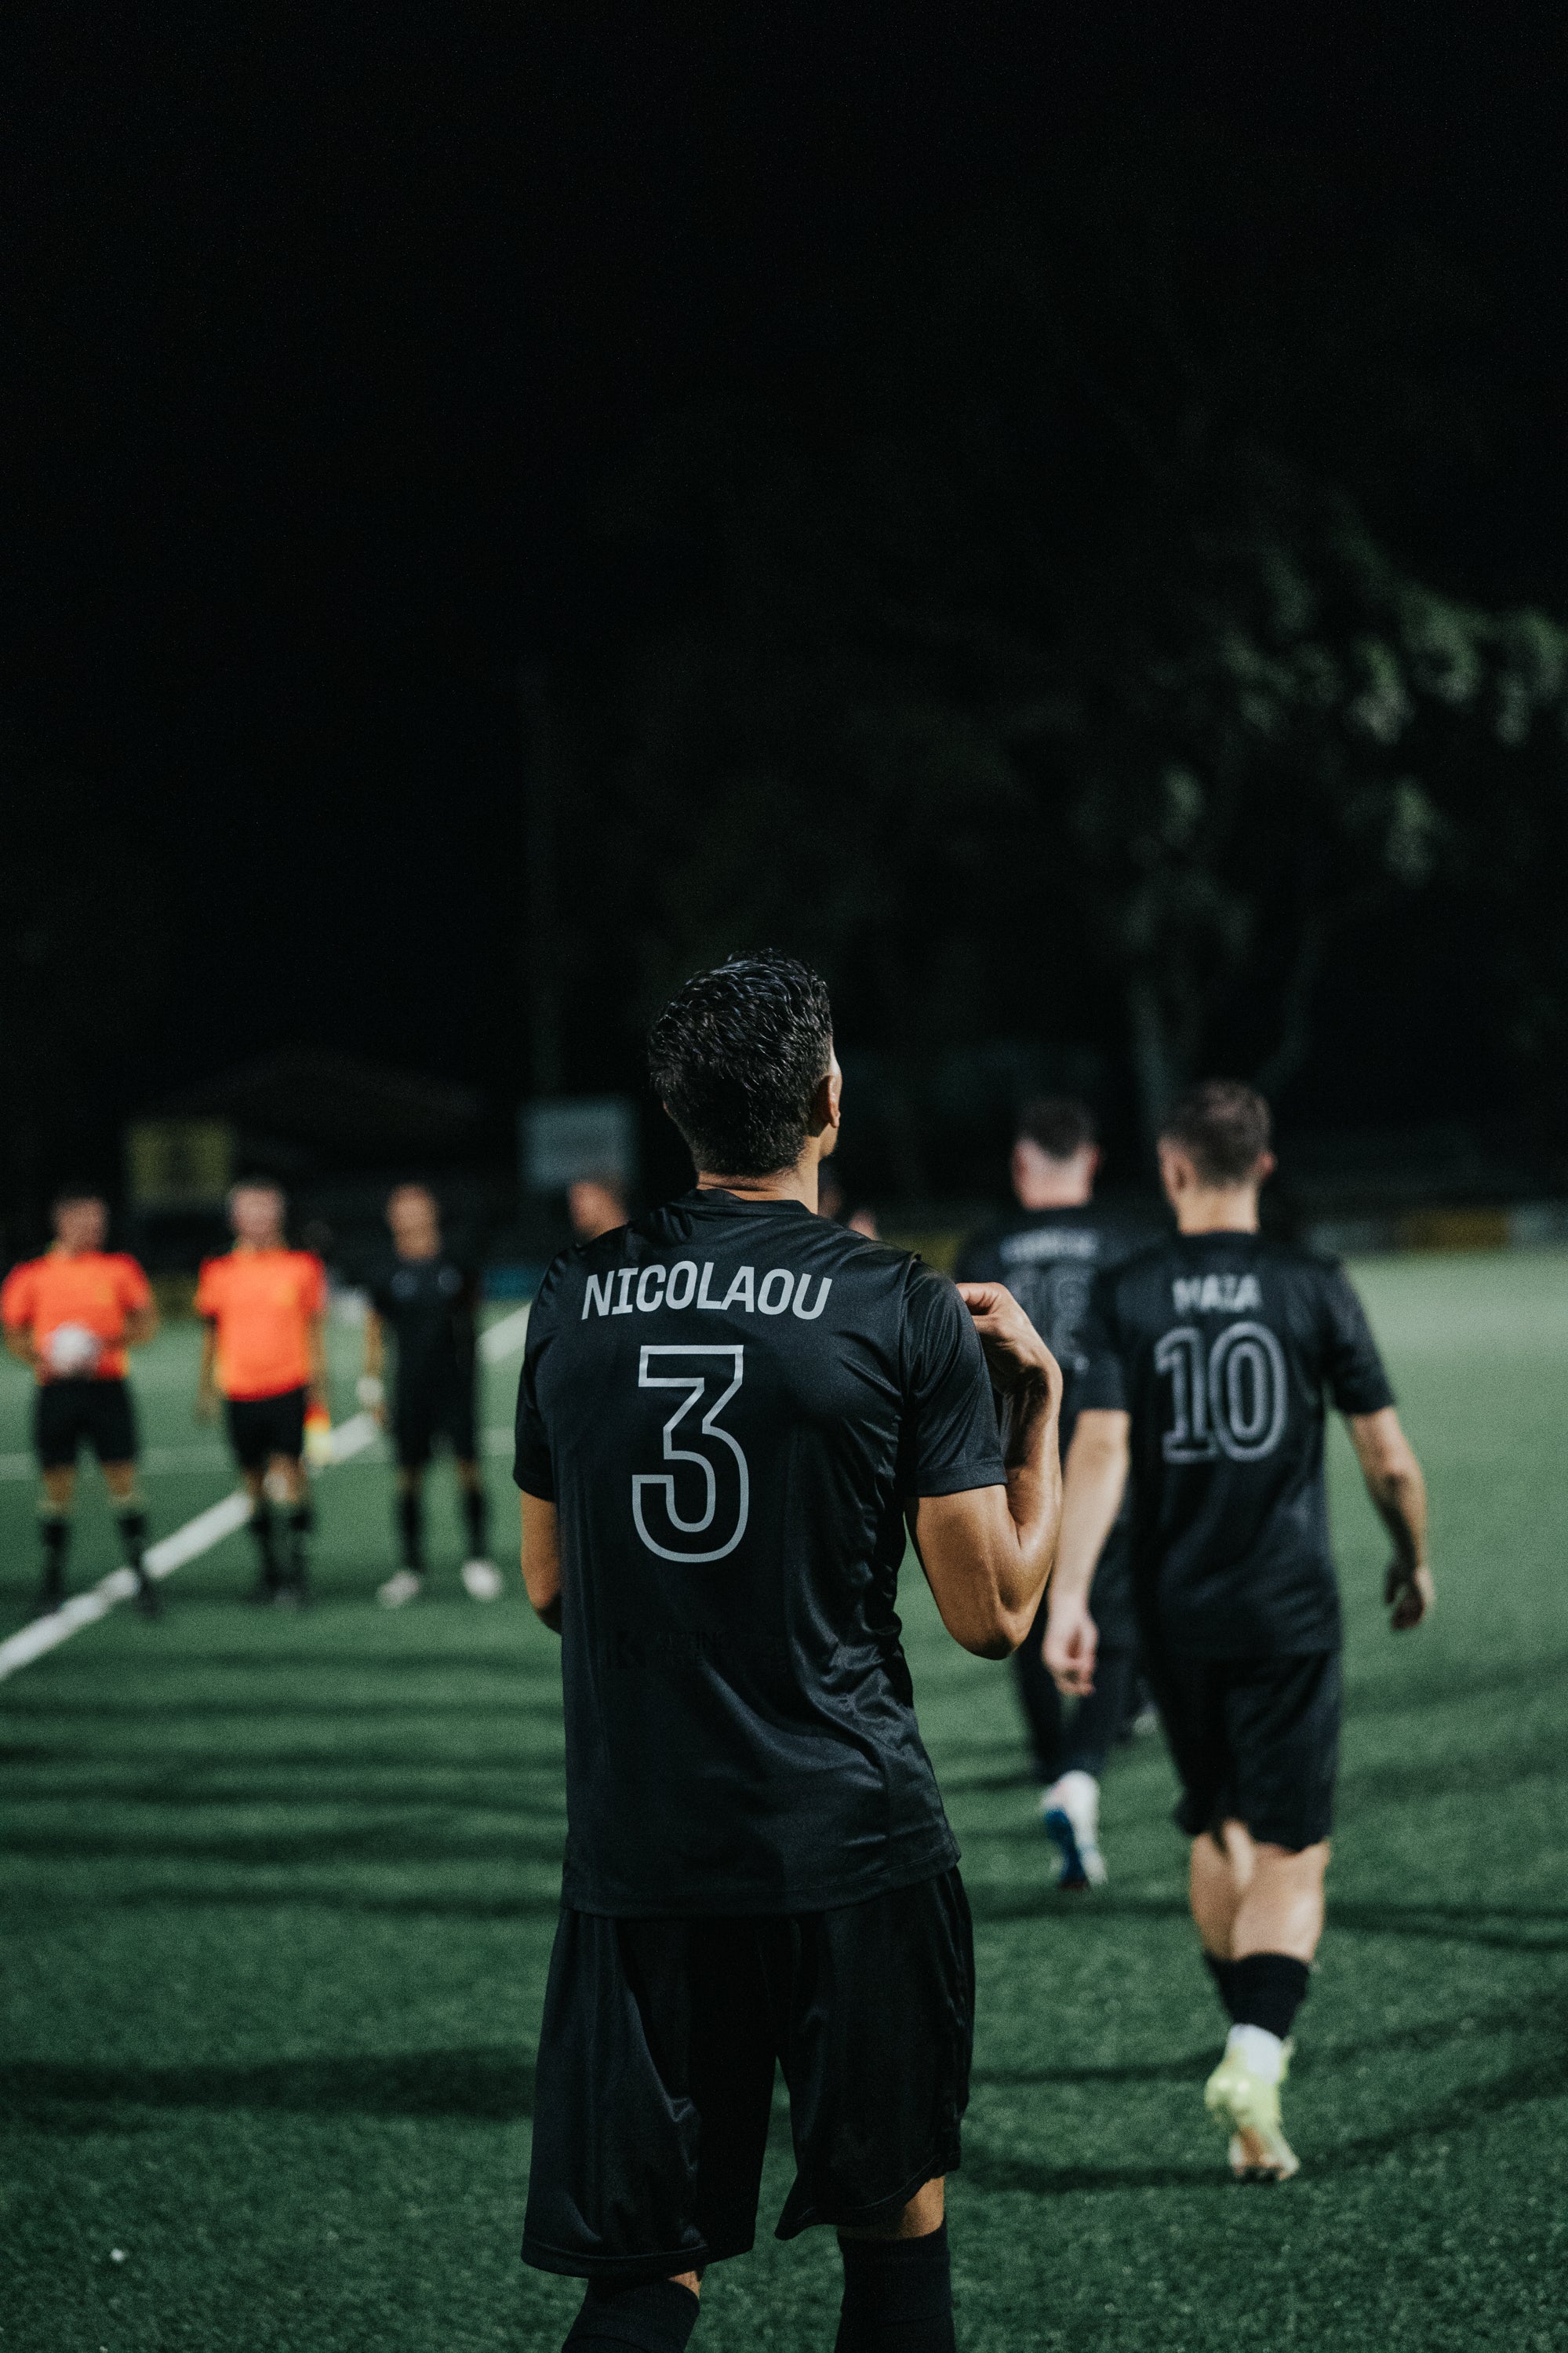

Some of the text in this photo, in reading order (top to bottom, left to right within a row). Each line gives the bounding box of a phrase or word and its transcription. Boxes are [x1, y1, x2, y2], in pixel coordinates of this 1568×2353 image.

[581, 1260, 832, 1320] NICOLAOU
[631, 1344, 749, 1563] 3
[1154, 1321, 1287, 1463] 10
